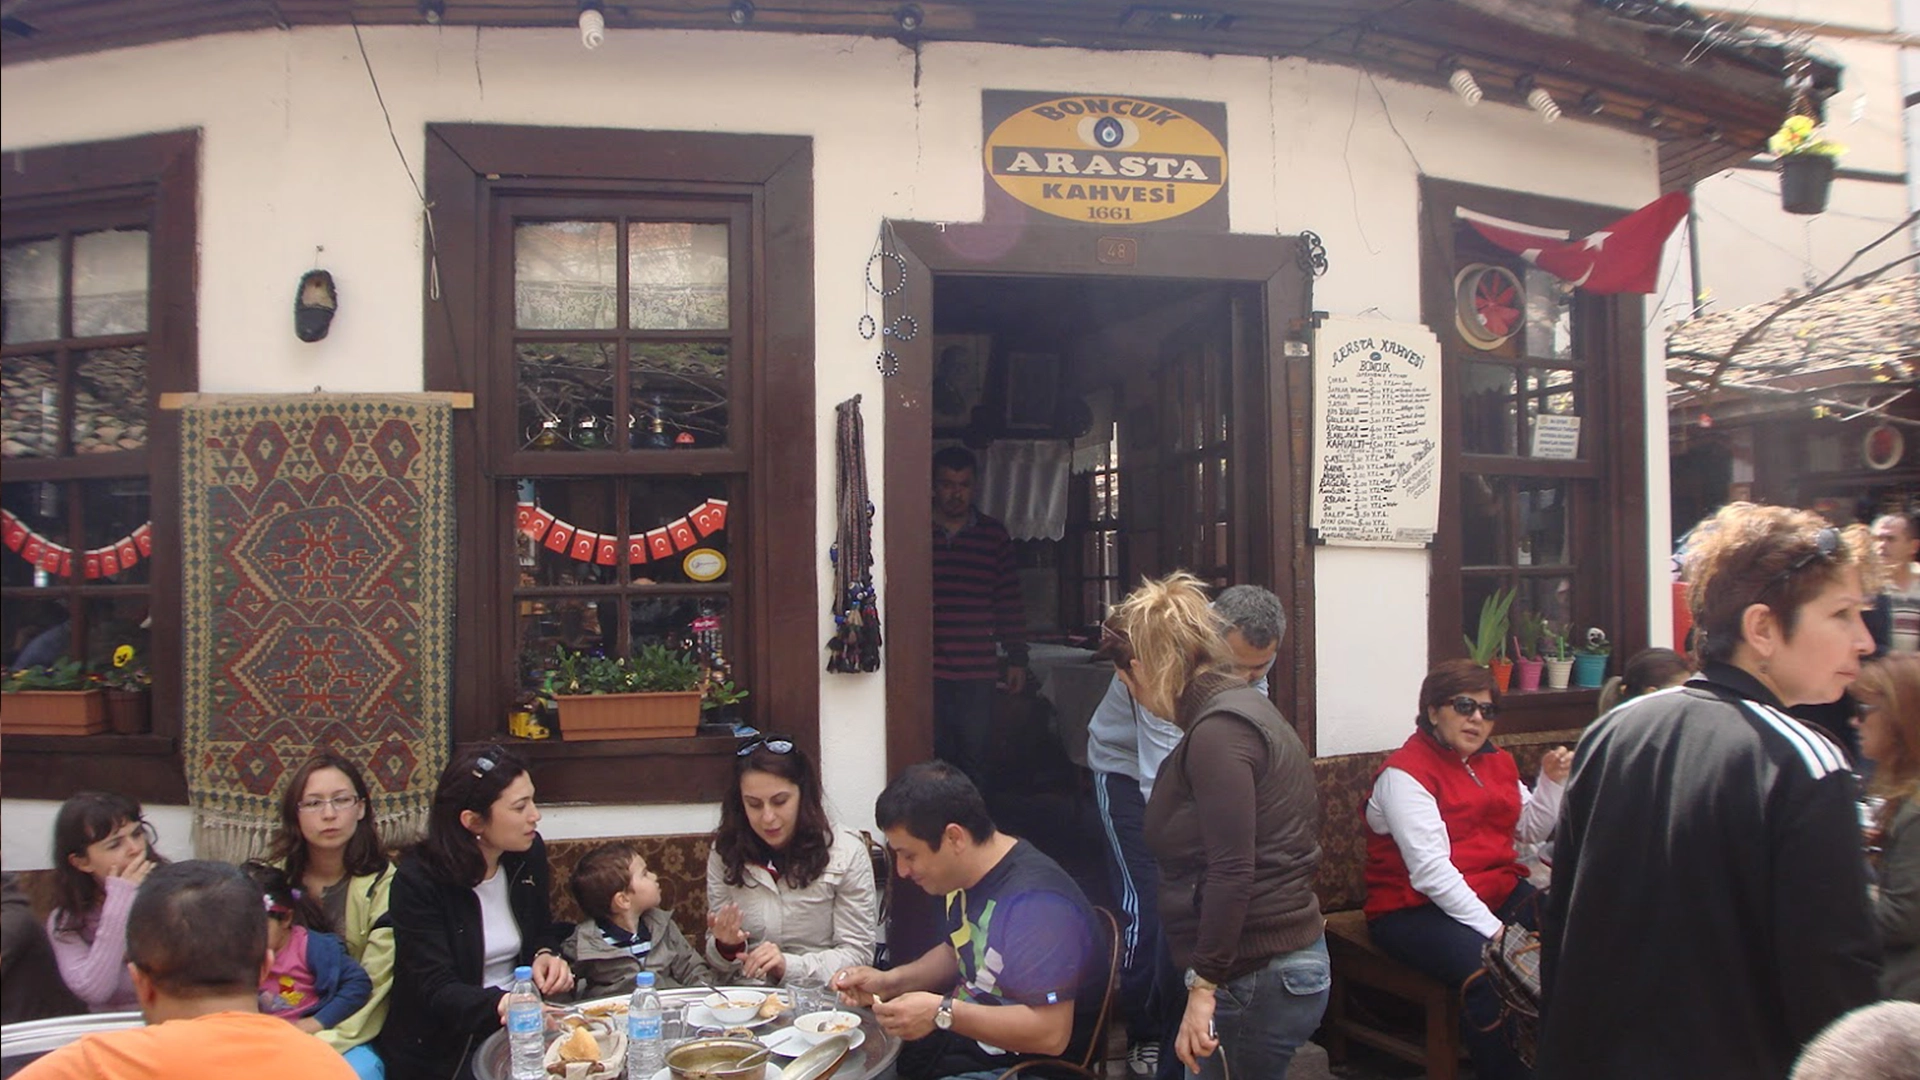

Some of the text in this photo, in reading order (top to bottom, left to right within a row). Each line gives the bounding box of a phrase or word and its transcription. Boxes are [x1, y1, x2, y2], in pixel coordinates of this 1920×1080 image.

[1031, 99, 1184, 126] BONCUK
[1006, 151, 1208, 181] ARASTA
[1042, 183, 1176, 204] KAHVESİ
[1086, 206, 1133, 221] 1661
[1107, 243, 1126, 258] 48
